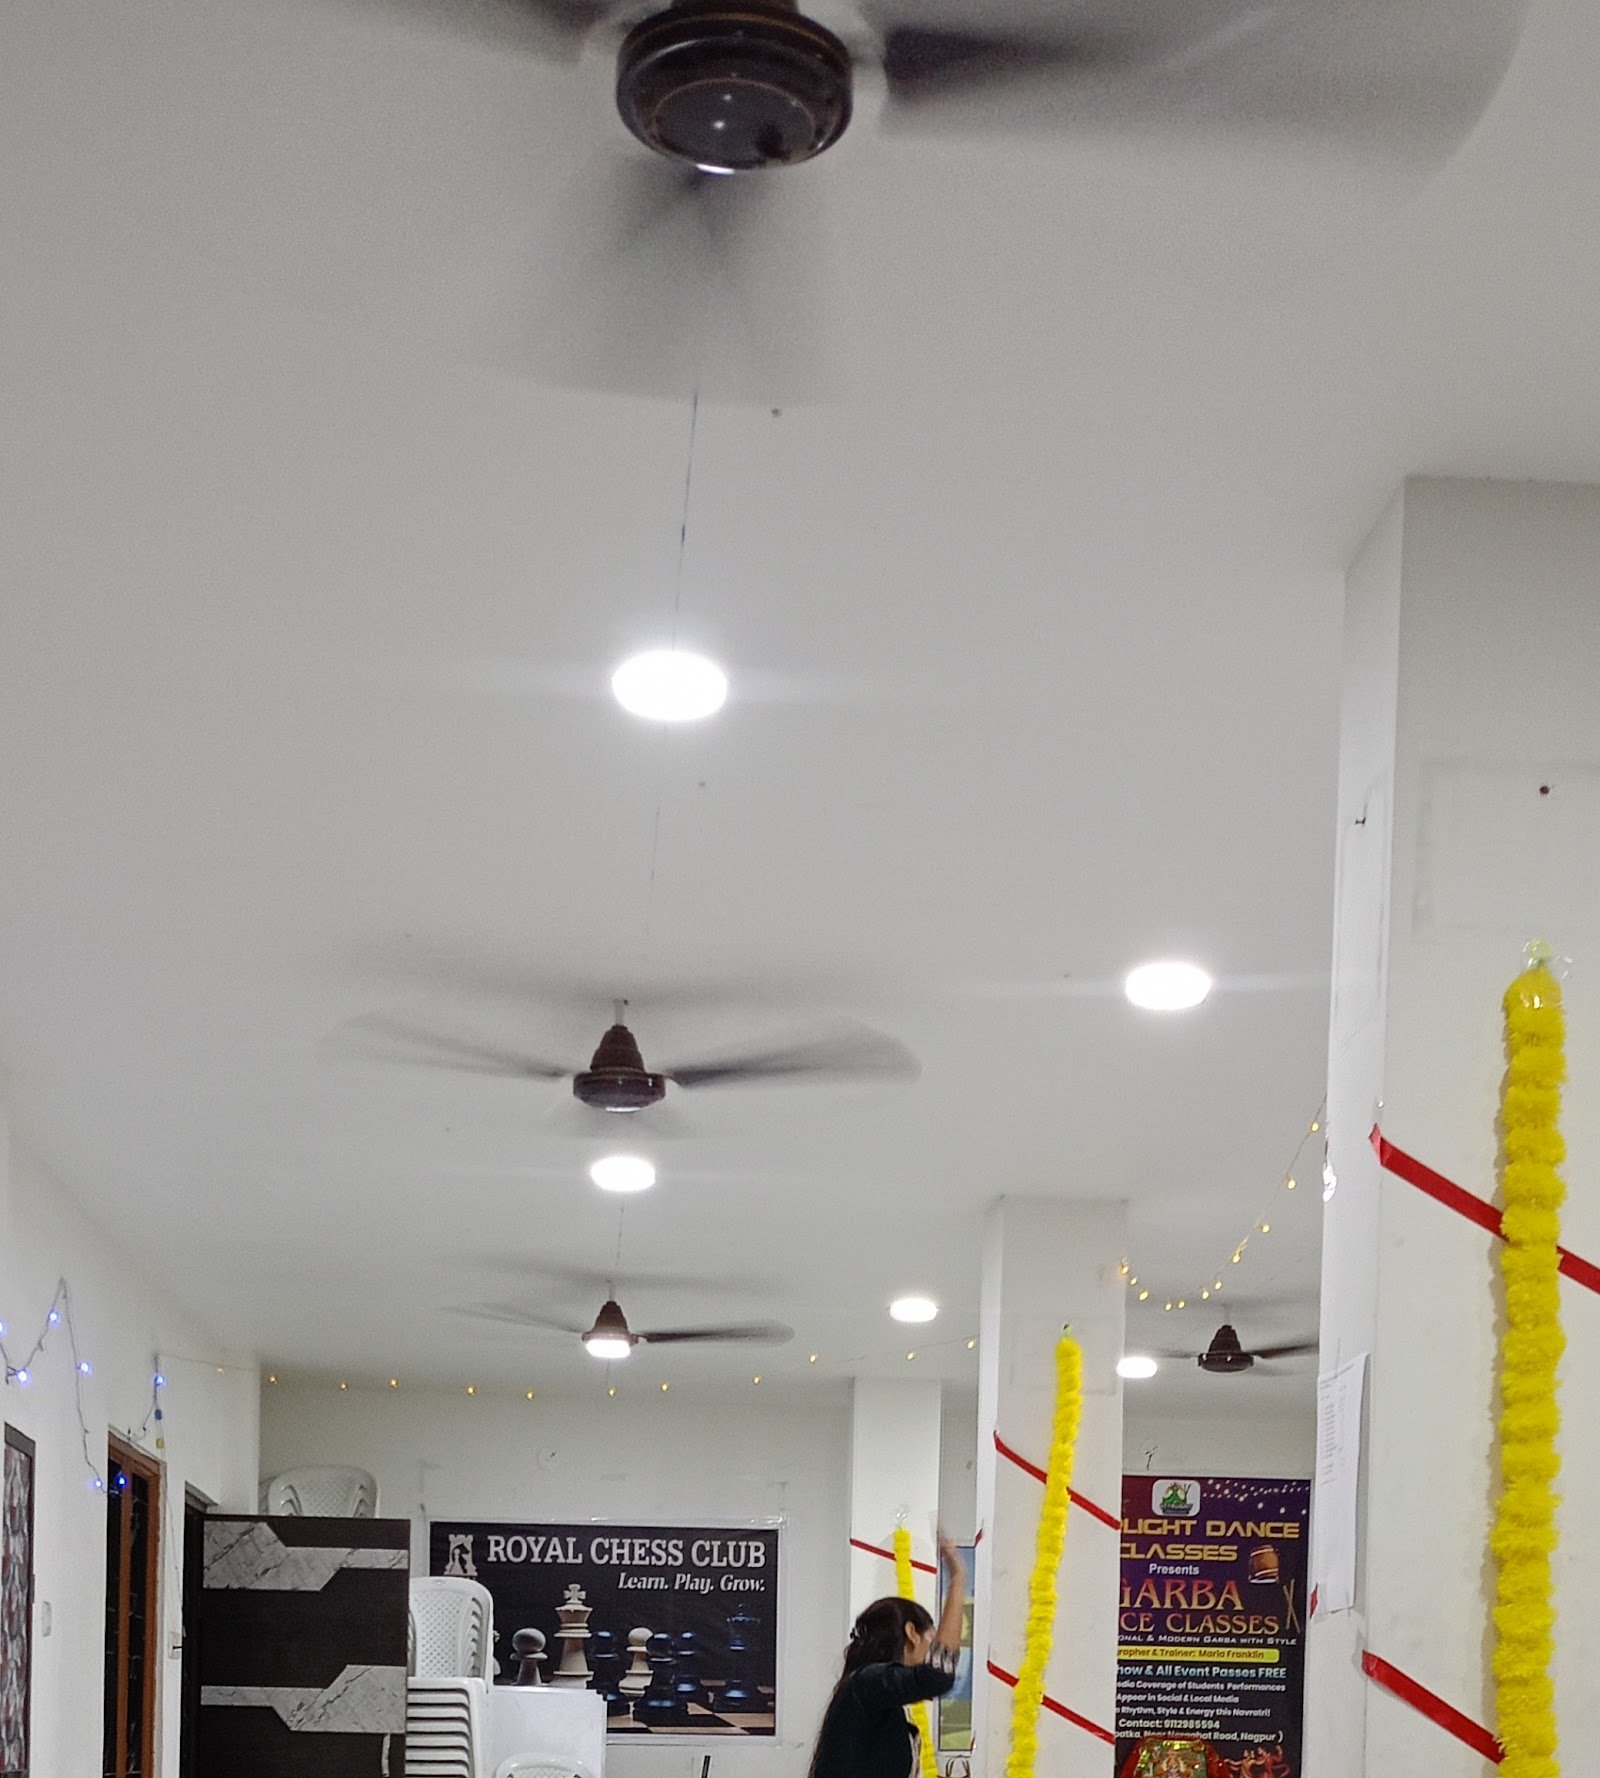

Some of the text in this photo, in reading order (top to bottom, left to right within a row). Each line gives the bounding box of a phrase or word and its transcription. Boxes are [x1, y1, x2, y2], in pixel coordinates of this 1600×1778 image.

[1120, 1518, 1300, 1538] LIGHT DANCE
[487, 1535, 766, 1569] ROYAL CHESS CLUB
[1149, 1563, 1200, 1576] Presents
[618, 1572, 766, 1595] Learn. Play. Grow.
[1166, 1614, 1280, 1634] CLASSES
[1144, 1665, 1154, 1676] &
[1156, 1665, 1173, 1676] All
[1174, 1665, 1210, 1677] Event
[1212, 1666, 1256, 1678] Passes
[1258, 1667, 1287, 1679] FREE
[1136, 1681, 1177, 1691] Coverage
[1178, 1681, 1186, 1689] of
[1119, 1719, 1163, 1729] Contact:
[1241, 1732, 1276, 1743] Nagpur
